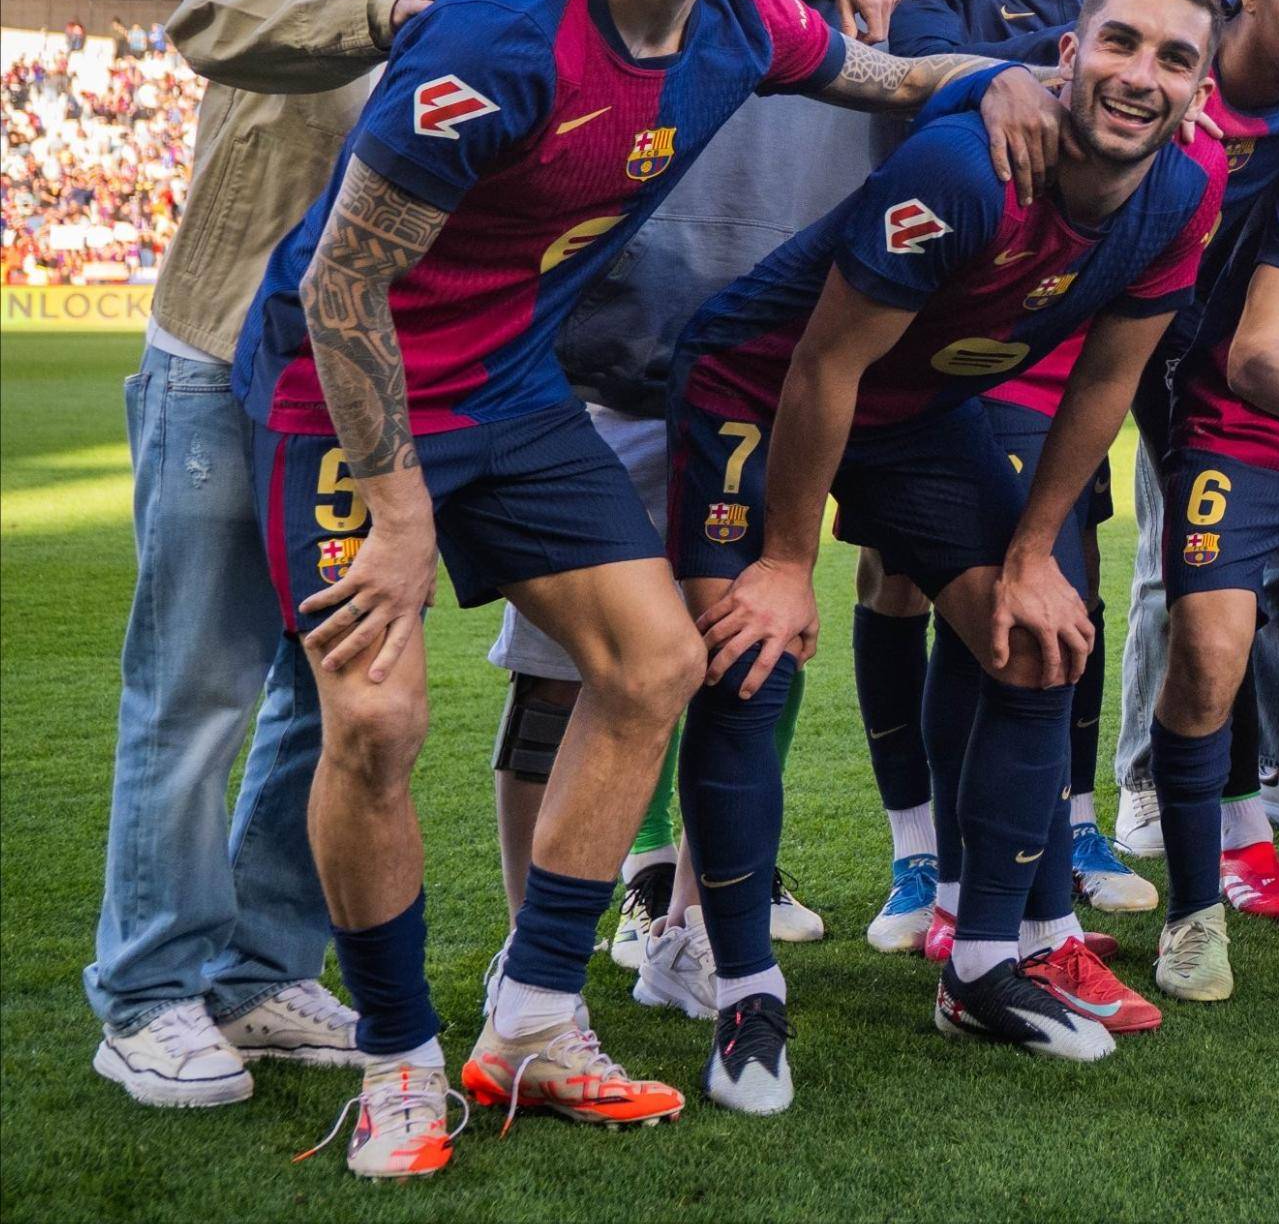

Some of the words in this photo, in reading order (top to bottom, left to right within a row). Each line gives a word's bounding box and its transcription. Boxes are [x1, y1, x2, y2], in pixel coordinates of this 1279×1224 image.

[315, 447, 368, 532] 5
[718, 421, 762, 493] 7
[1187, 469, 1232, 526] 6
